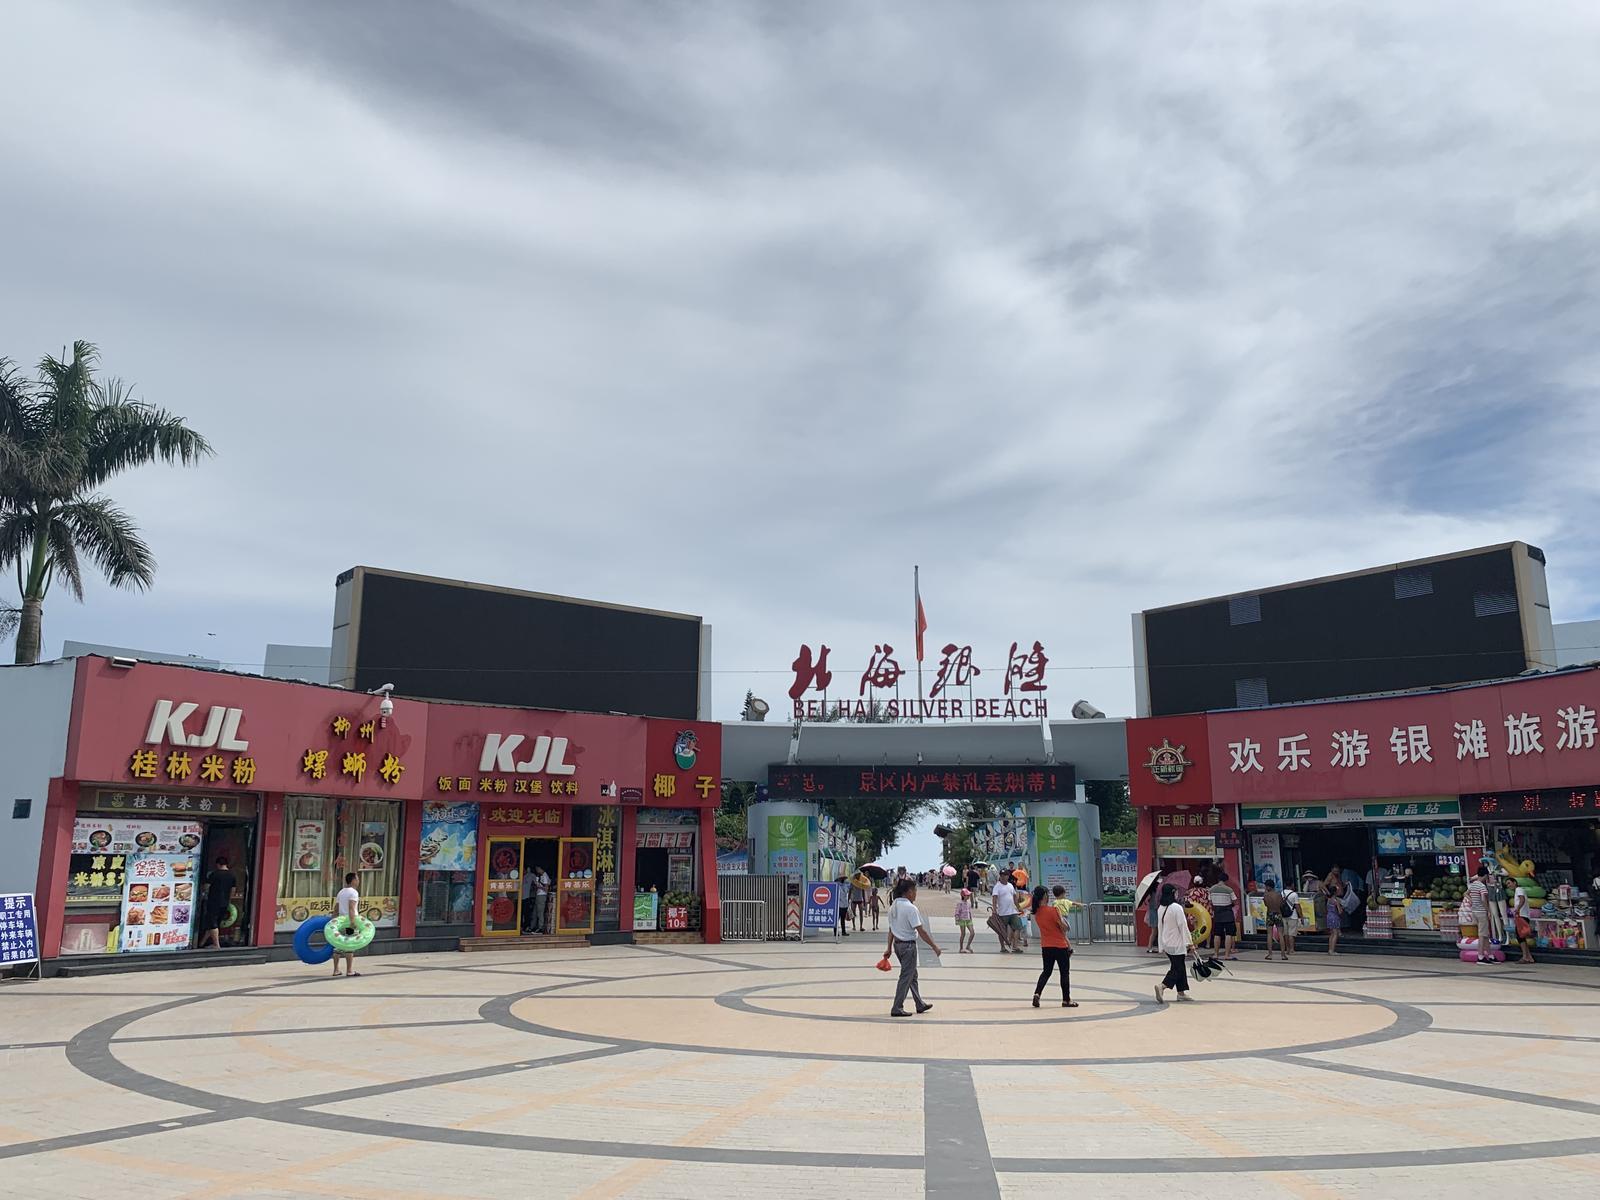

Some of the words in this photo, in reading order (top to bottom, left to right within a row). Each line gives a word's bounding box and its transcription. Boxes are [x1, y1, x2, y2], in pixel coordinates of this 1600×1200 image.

[793, 699, 826, 718] BEI
[838, 699, 874, 718] HAI
[888, 699, 964, 718] SILVER
[975, 698, 1048, 718] BEACH
[144, 699, 249, 753] KJL
[332, 715, 375, 744] 柳州
[1227, 704, 1599, 774] 欢乐游银滩旅游
[478, 733, 576, 775] KJL
[130, 749, 257, 785] 桂林米粉
[302, 748, 406, 785] 螺蛳粉
[653, 773, 716, 799] 椰子
[133, 795, 213, 811] 桂林米粉
[1383, 802, 1441, 815] 甜品站
[489, 807, 561, 824] 欢迎光临
[1259, 808, 1309, 819] 便利店
[596, 805, 615, 872] 冰淇淋
[1405, 837, 1434, 851] 半价
[602, 871, 616, 905] 椰子
[4, 896, 27, 910] 提示
[0, 909, 31, 920] 职工专用
[668, 907, 688, 918] 椰子
[808, 915, 834, 923] 车辆驶入
[1, 929, 33, 941] 外来车辆
[1, 939, 34, 951] 禁止入内
[2, 949, 35, 961] 后果自负
